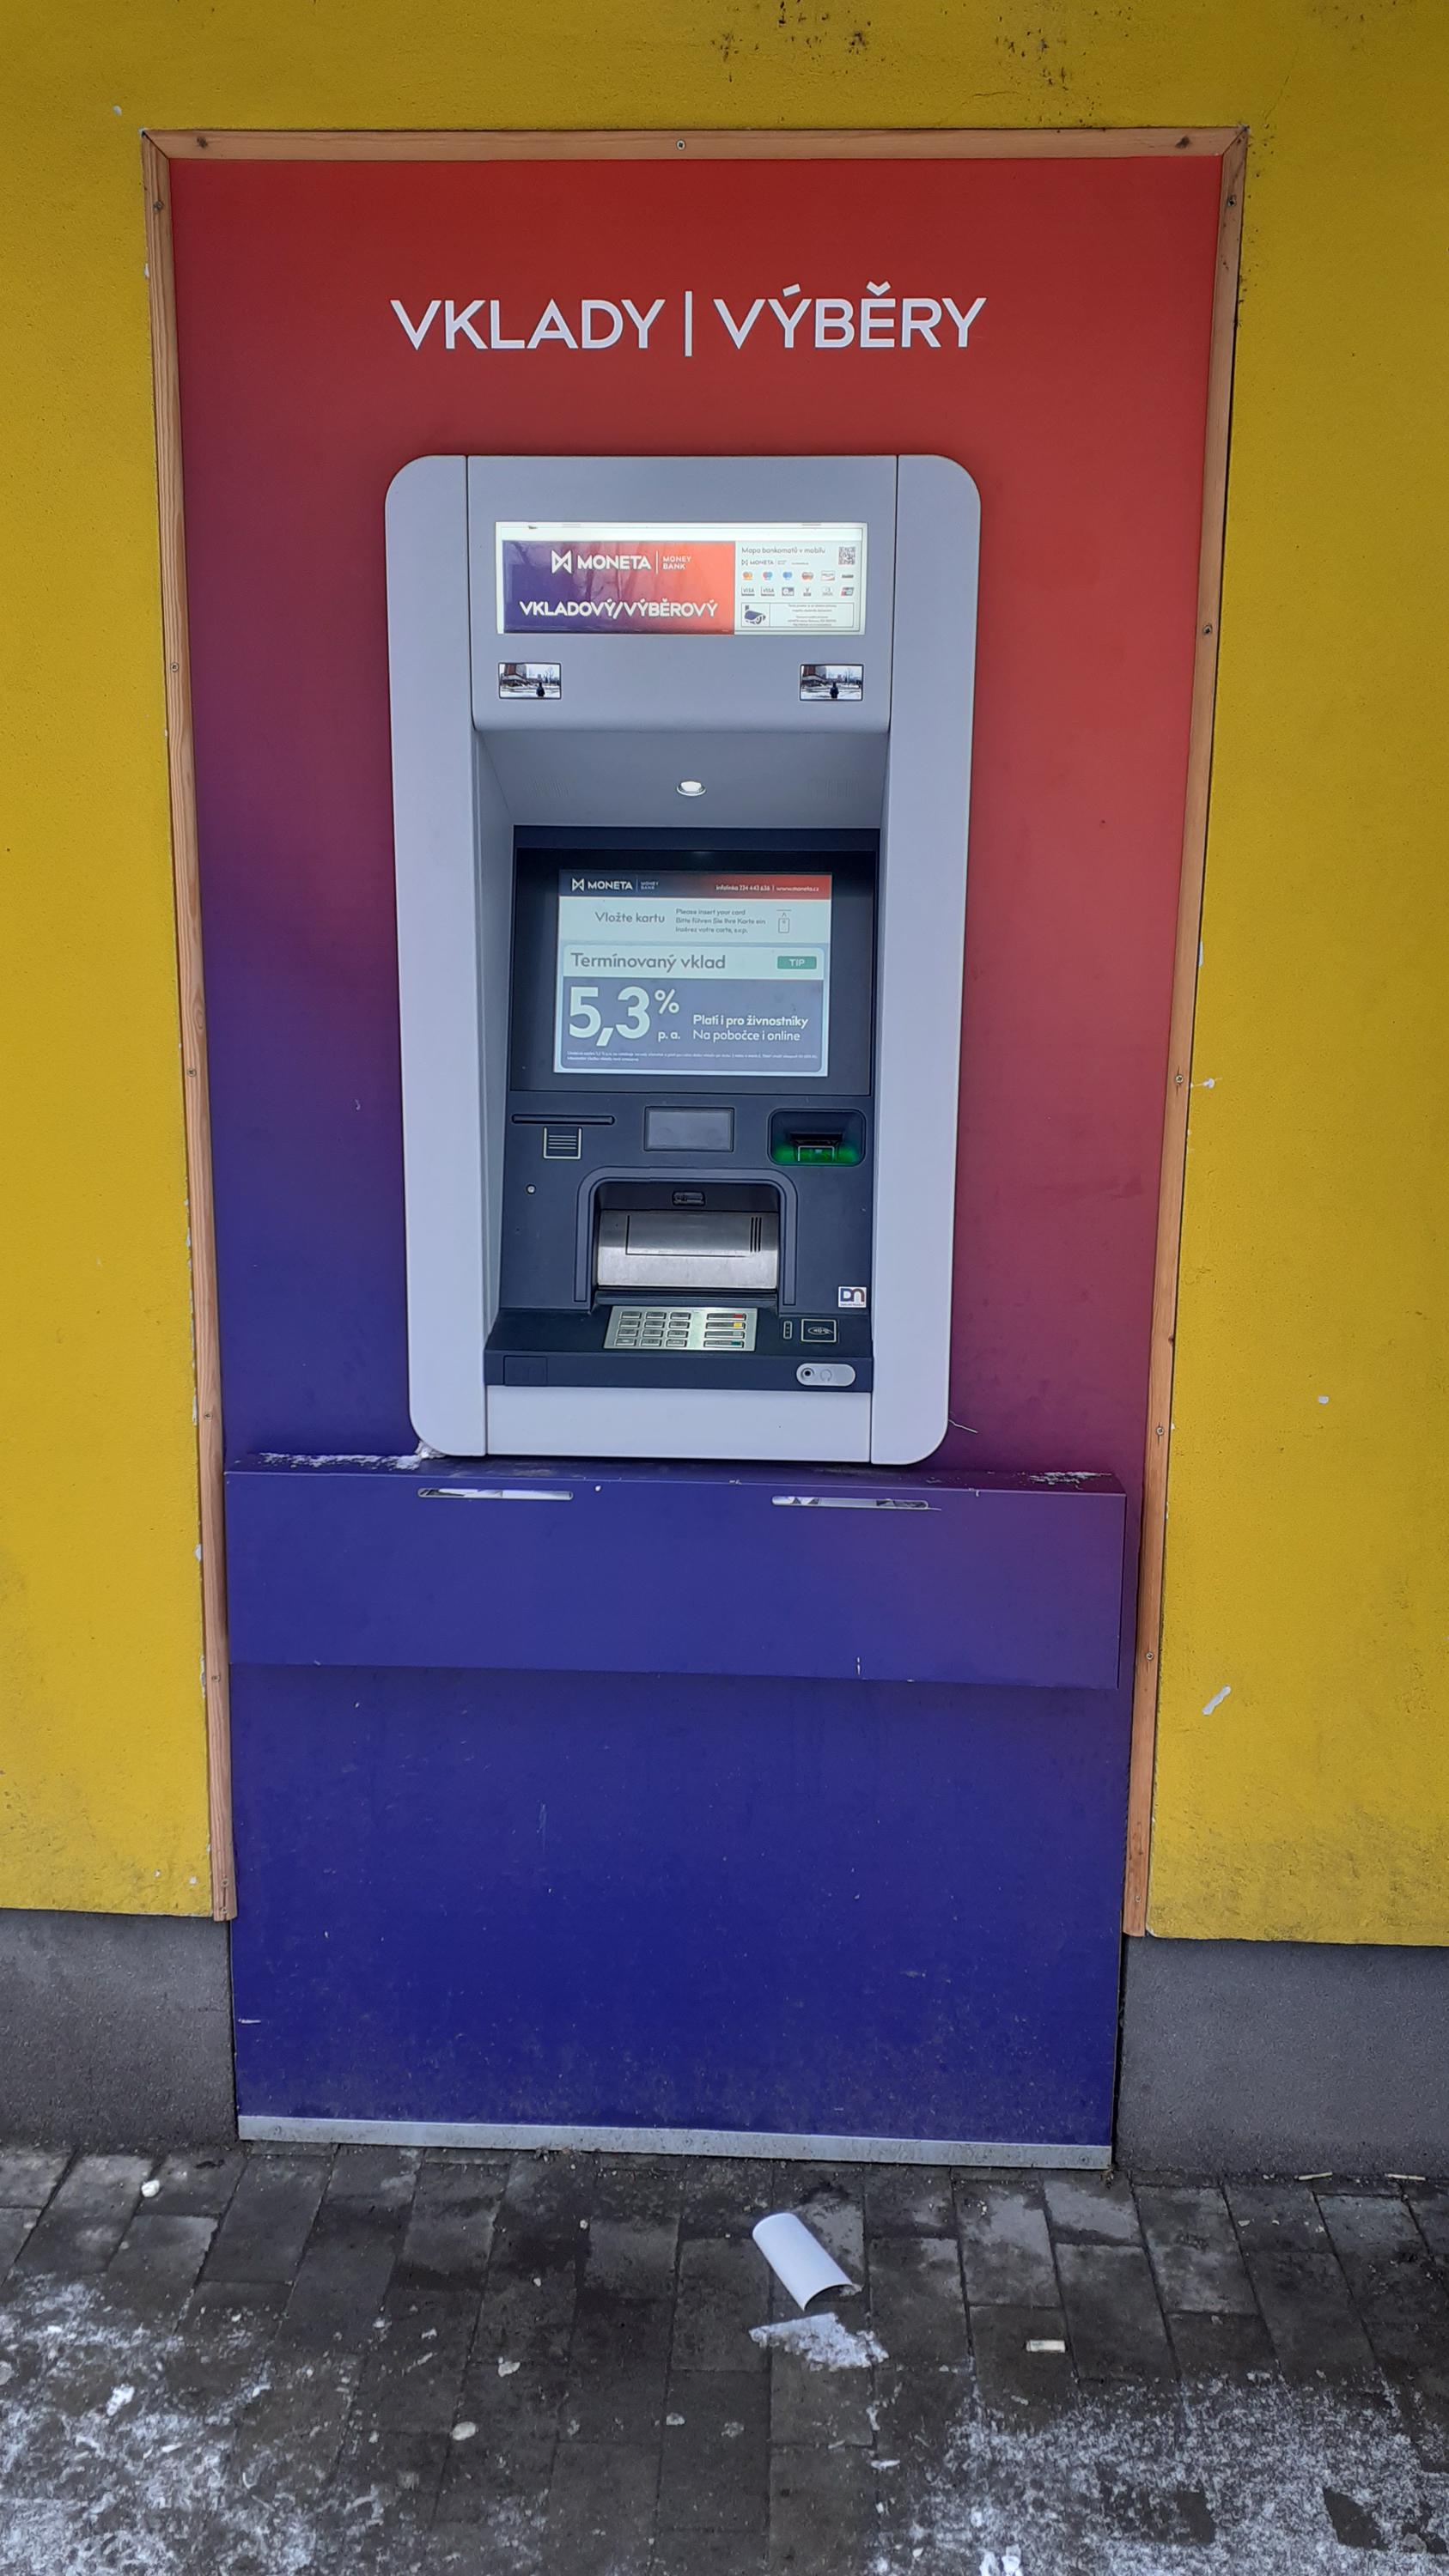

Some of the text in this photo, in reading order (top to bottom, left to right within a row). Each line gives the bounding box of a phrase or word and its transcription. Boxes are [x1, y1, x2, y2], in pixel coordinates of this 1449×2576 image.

[390, 299, 666, 350] VKLADY
[713, 280, 987, 349] VÝBĚRY
[577, 555, 652, 570] MONETA
[588, 880, 633, 890] MONETA
[594, 911, 666, 923] Vložte kartu
[570, 952, 726, 973] Termínovaný vklad
[788, 958, 805, 967] TIP
[693, 1013, 719, 1026] Platí
[726, 1017, 745, 1030] pro
[746, 1014, 809, 1030] živnostníky
[693, 1030, 711, 1041] Na
[713, 1030, 760, 1043] pobočce
[767, 1031, 801, 1042] online
